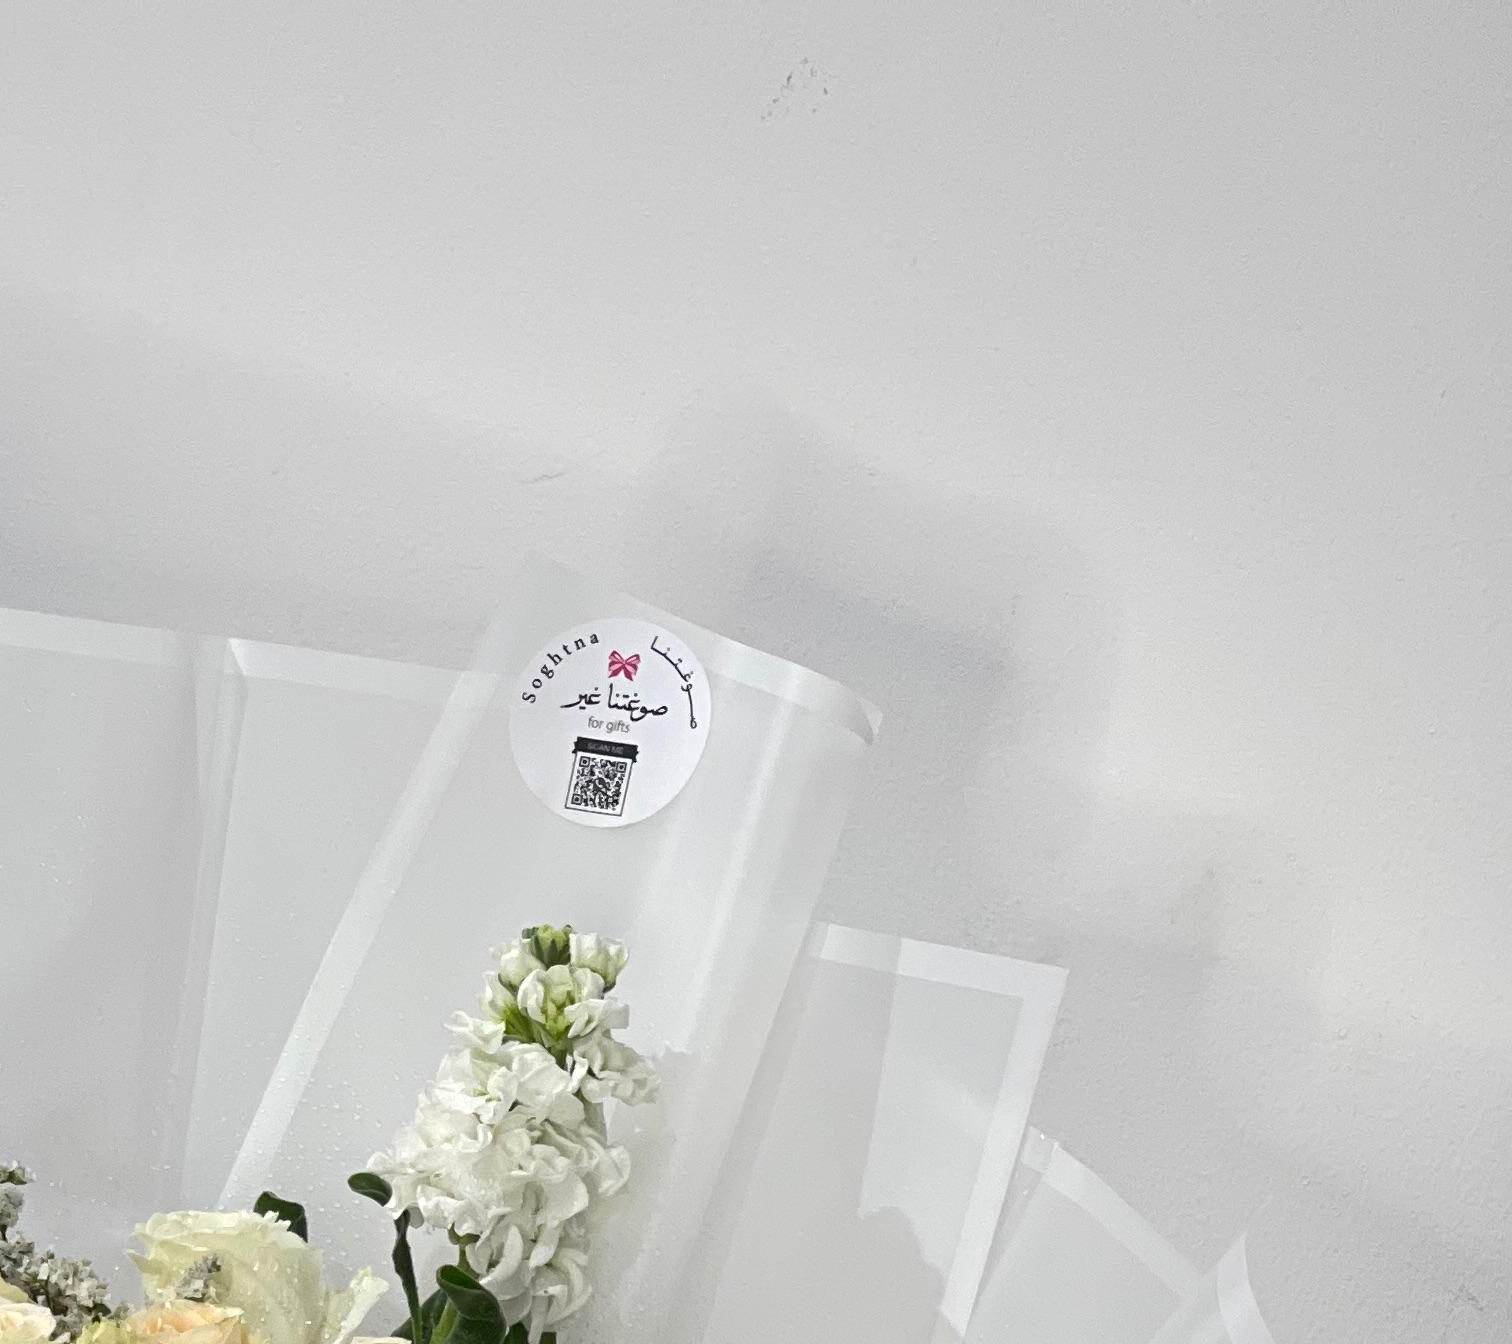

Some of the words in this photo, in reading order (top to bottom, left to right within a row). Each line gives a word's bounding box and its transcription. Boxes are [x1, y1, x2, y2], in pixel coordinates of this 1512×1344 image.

[521, 633, 599, 703] Soghtna
[559, 686, 602, 710] غير
[607, 682, 669, 722] صوغتنا
[587, 715, 604, 729] for
[605, 719, 631, 734] gifts
